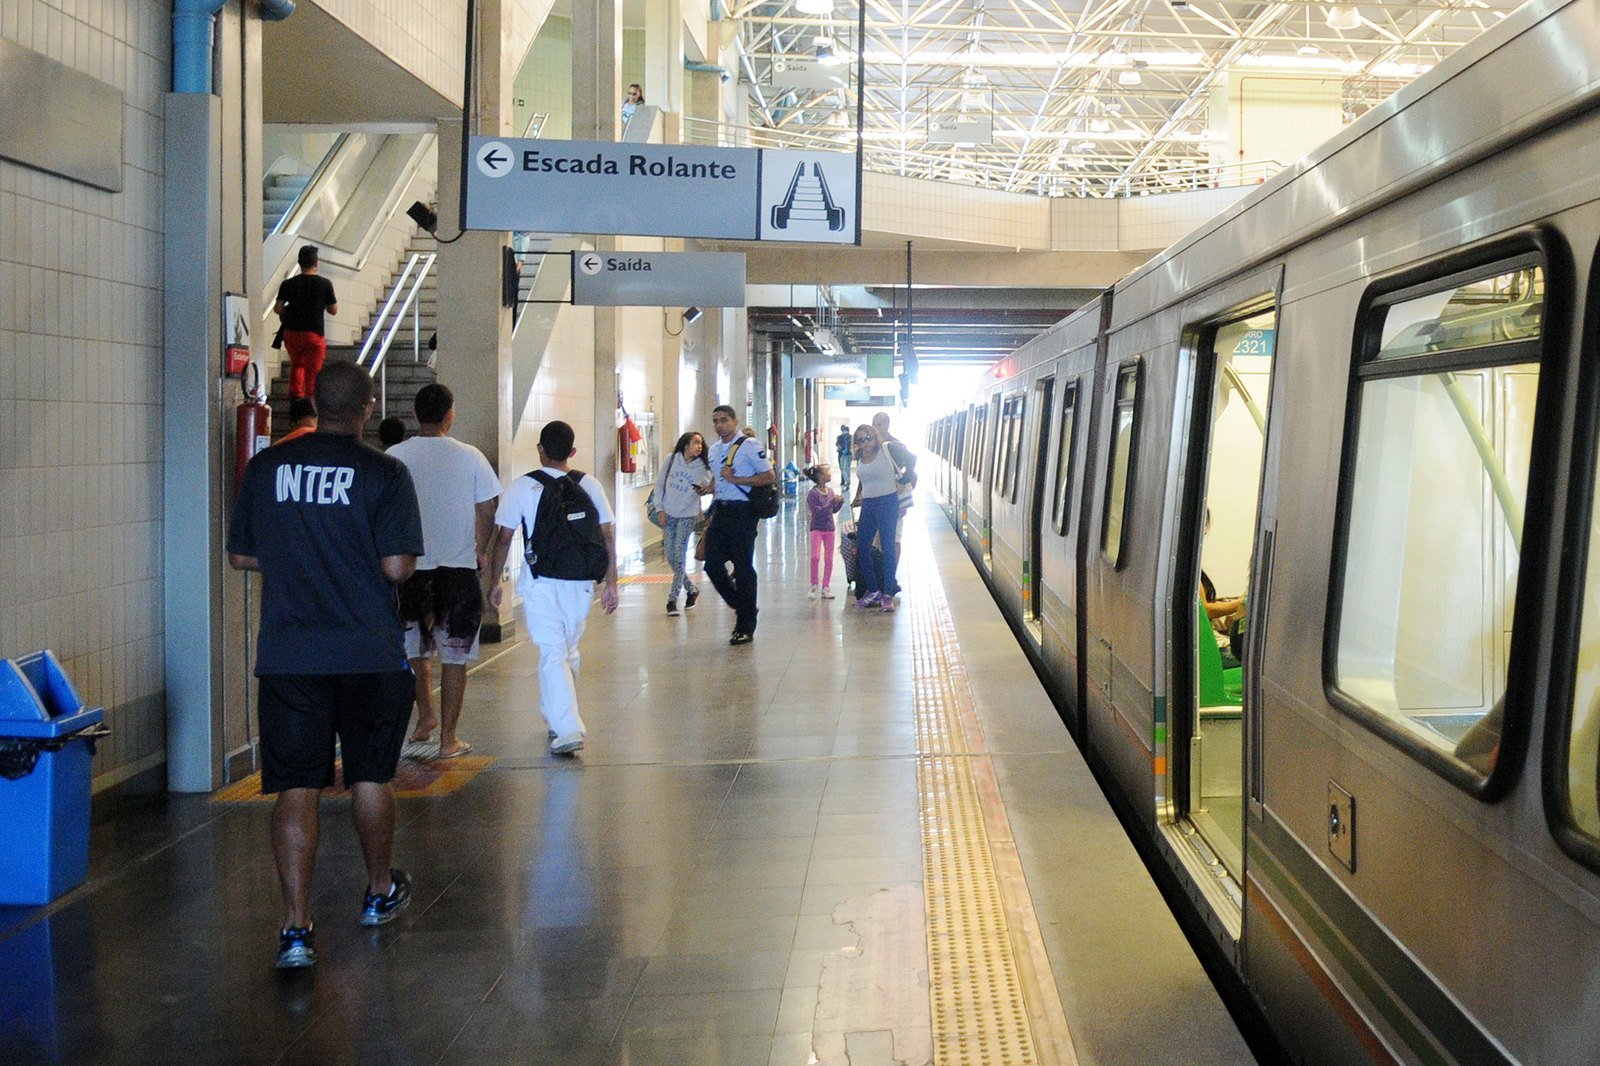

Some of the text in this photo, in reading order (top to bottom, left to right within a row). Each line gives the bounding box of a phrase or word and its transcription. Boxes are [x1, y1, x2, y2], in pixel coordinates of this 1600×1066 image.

[522, 150, 737, 180] Escada Rolante
[606, 257, 652, 272] Saída
[1233, 339, 1267, 354] 2321
[276, 463, 356, 506] INTER
